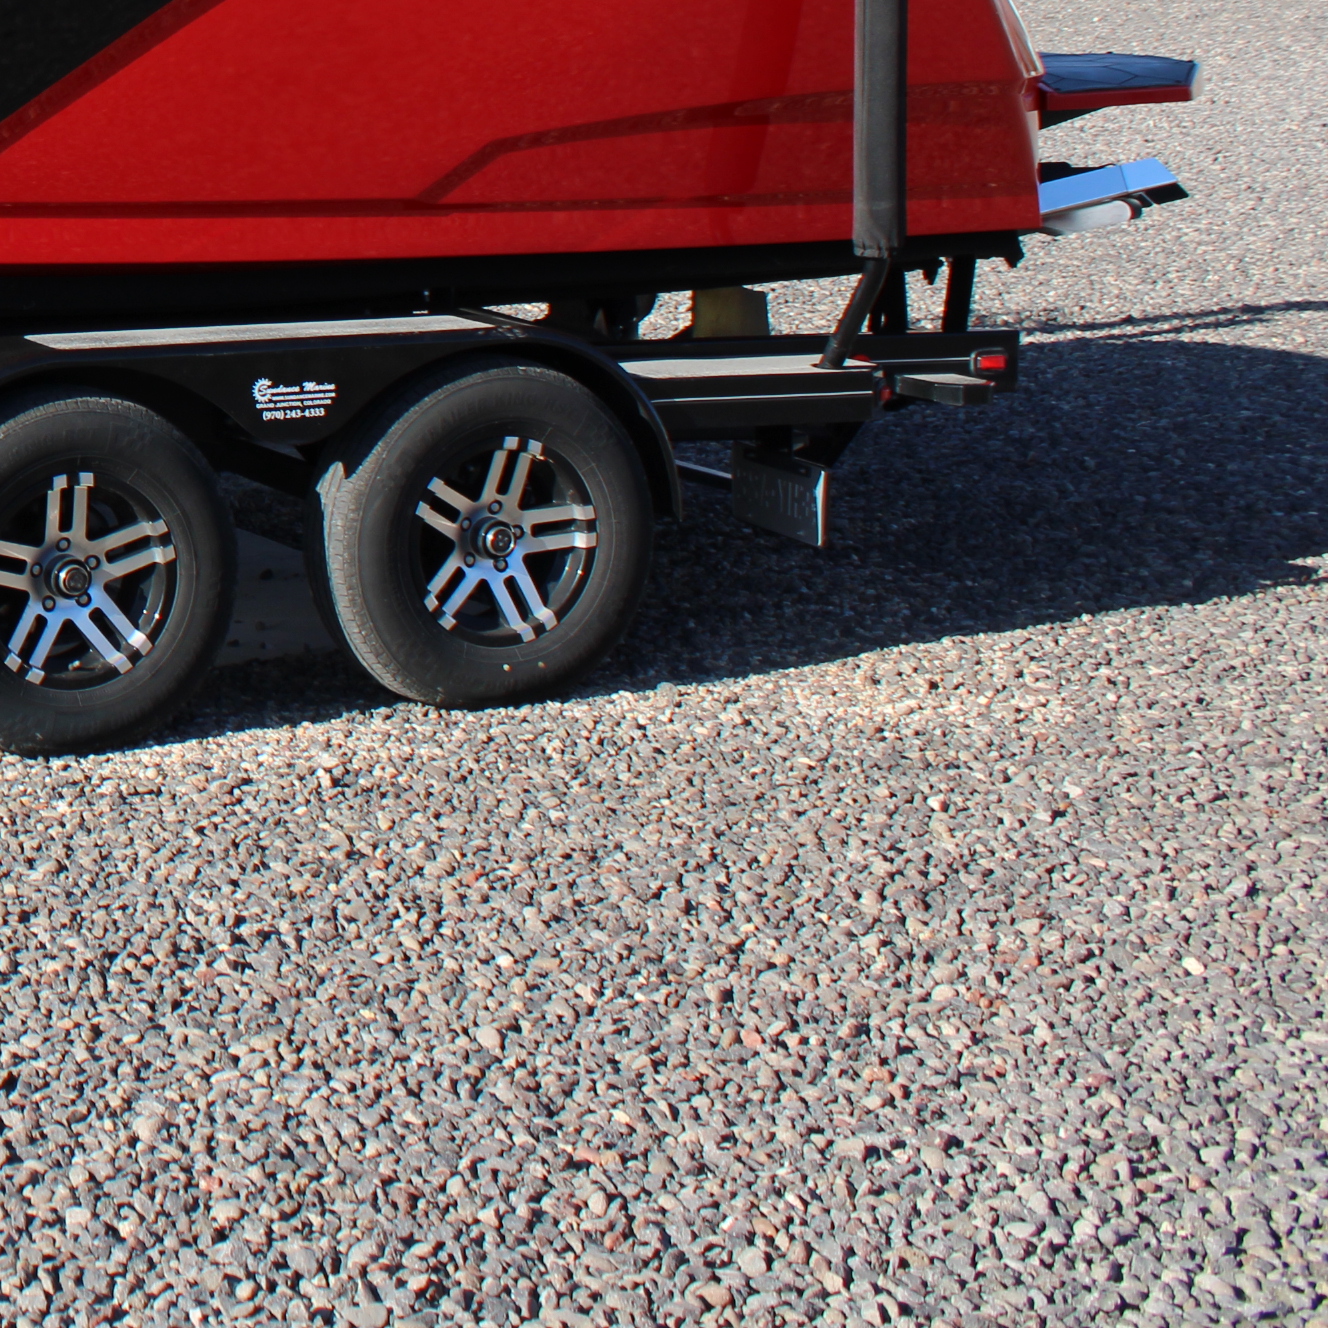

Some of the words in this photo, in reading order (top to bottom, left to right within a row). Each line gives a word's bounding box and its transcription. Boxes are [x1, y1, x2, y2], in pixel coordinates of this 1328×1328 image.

[257, 383, 301, 396] Sundance
[302, 381, 336, 392] Marine
[262, 409, 285, 421] (970)
[285, 407, 325, 419] 243-4333
